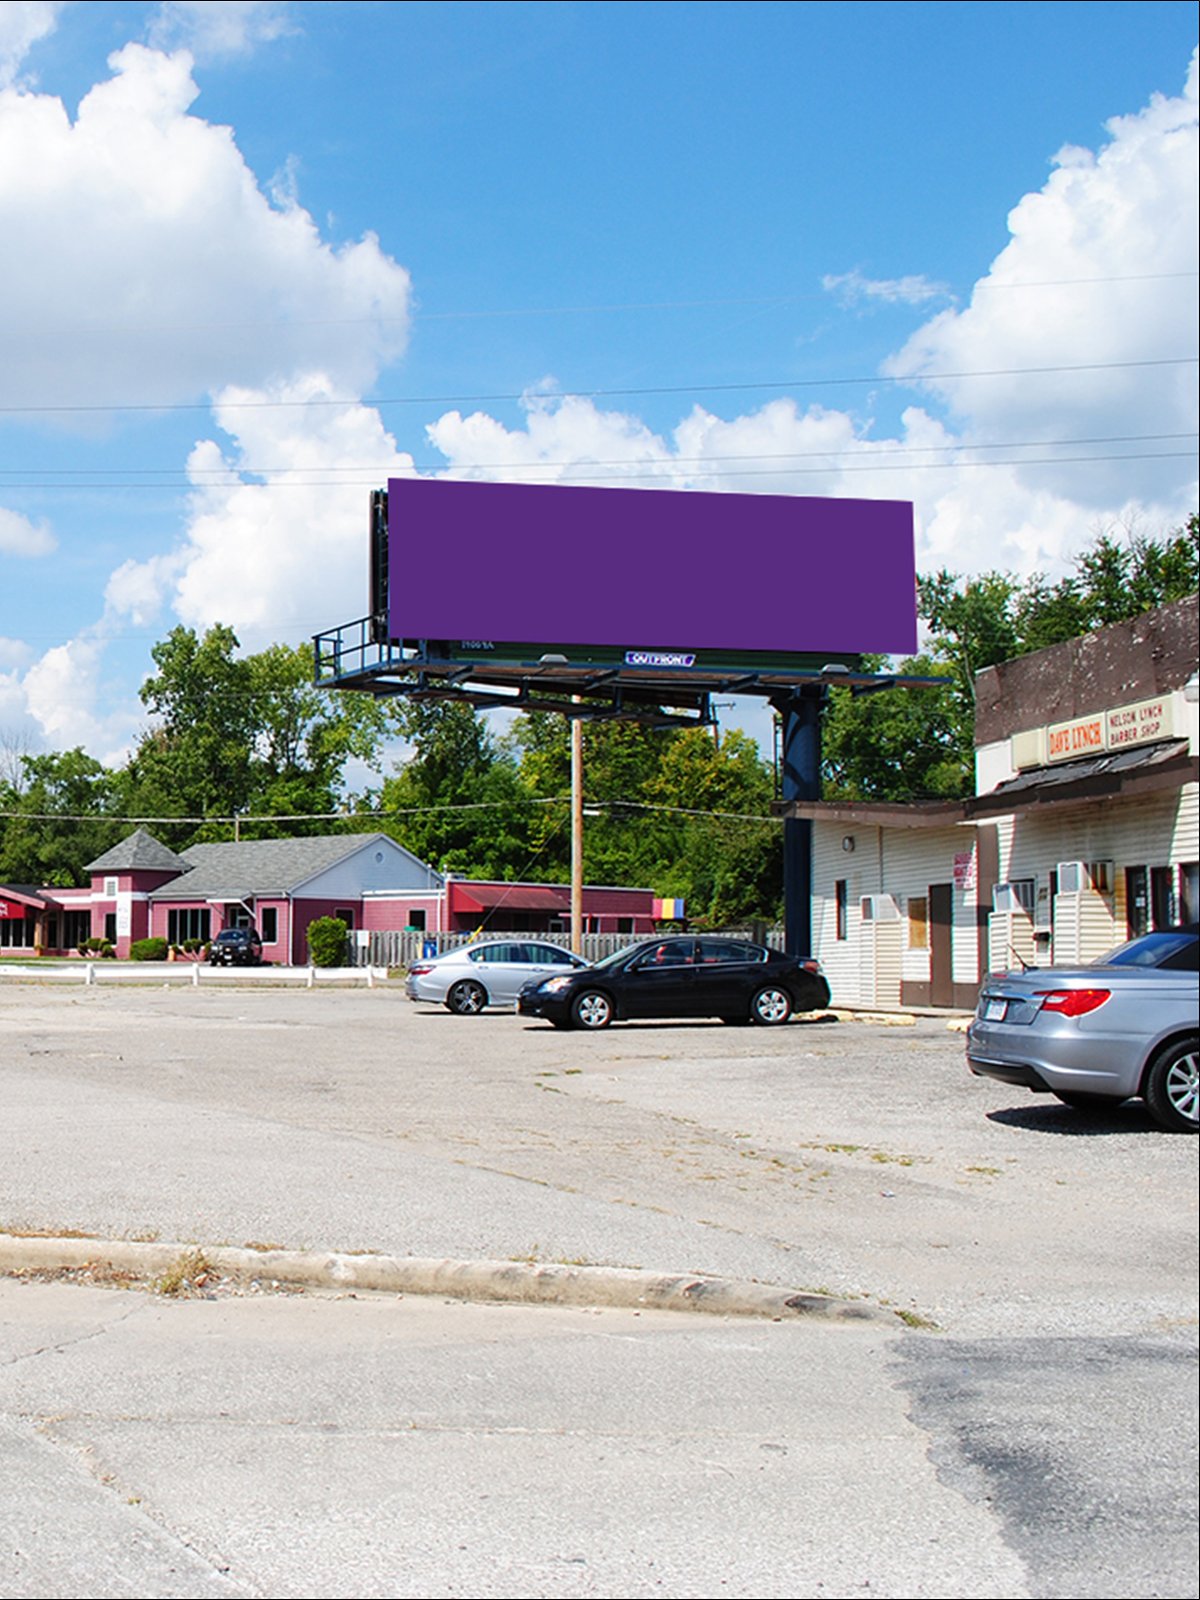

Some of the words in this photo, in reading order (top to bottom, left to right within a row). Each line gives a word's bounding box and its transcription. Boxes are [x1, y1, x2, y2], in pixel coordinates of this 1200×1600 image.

[632, 652, 685, 665] OUTFRONT
[1110, 712, 1136, 728] NELSON
[1140, 704, 1162, 721] LYNCH
[1049, 729, 1070, 755] DAVE
[1072, 721, 1102, 750] LYNCH
[1110, 727, 1137, 746] BARBER
[1141, 721, 1160, 738] SHOP
